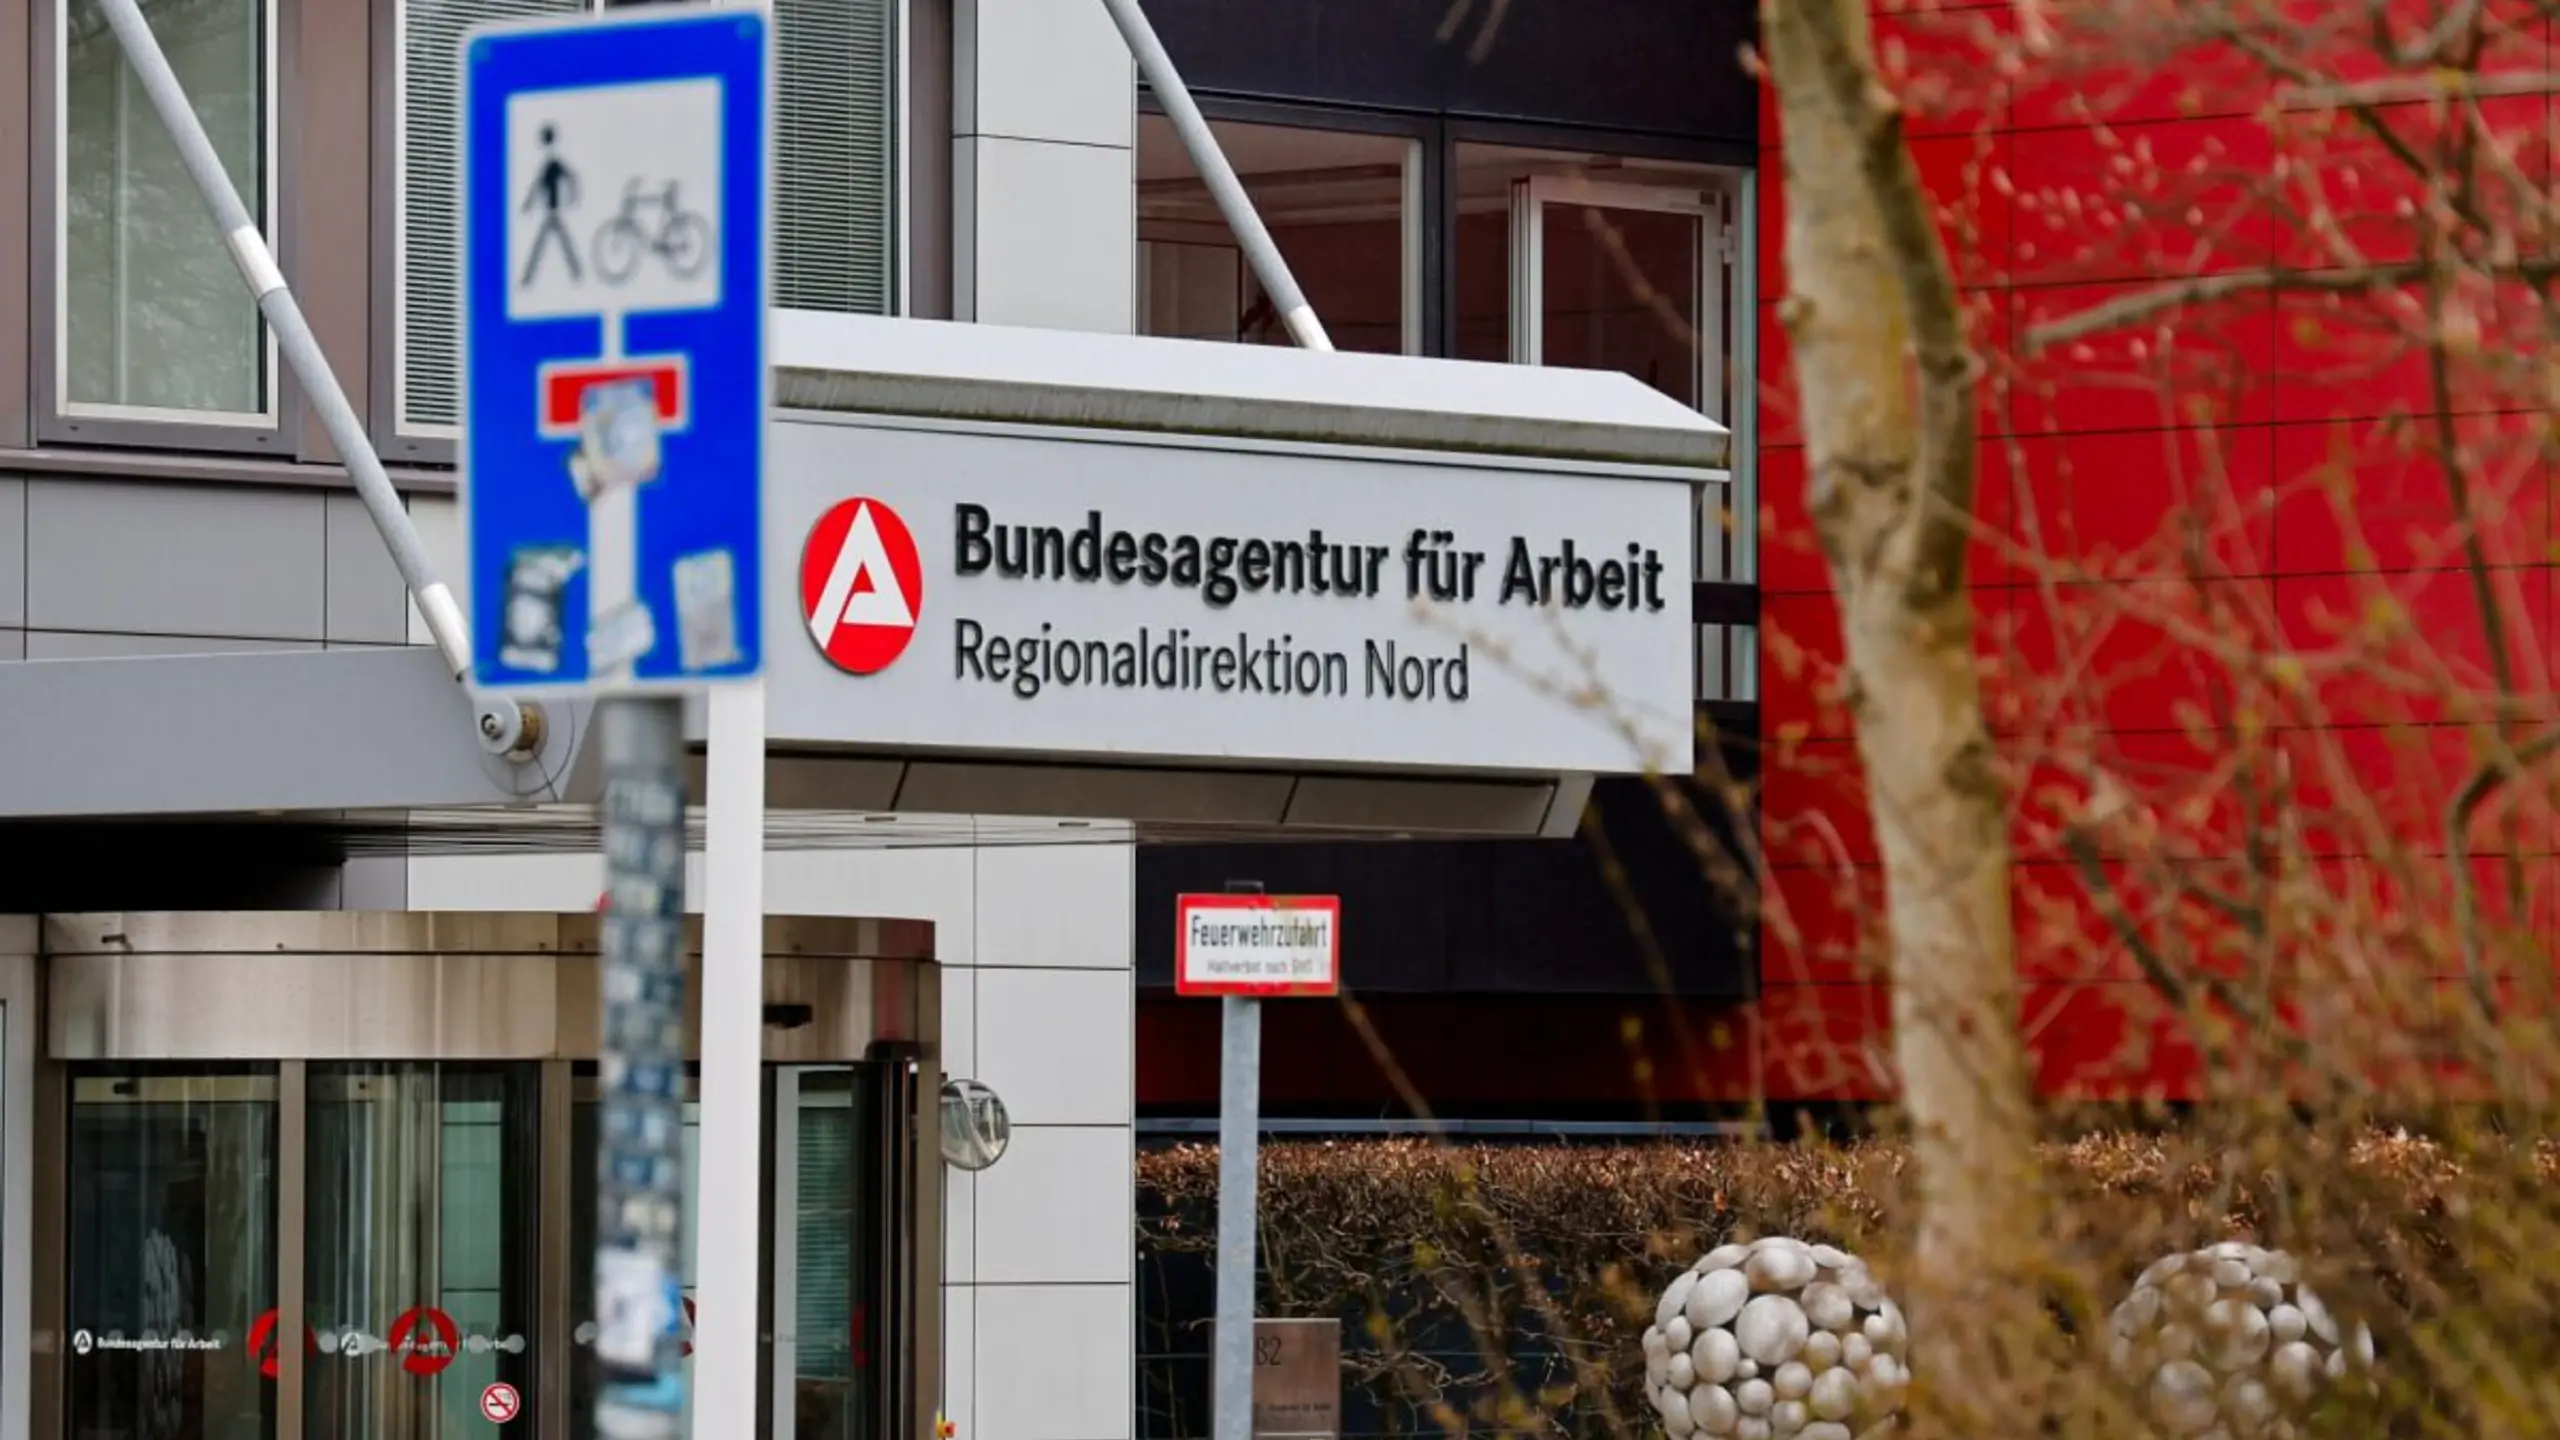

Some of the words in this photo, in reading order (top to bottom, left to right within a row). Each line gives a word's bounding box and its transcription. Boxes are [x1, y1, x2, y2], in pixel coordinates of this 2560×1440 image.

[955, 503, 1389, 605] Bundesagentur
[1402, 528, 1486, 602] für
[1499, 536, 1666, 613] Arbeit
[955, 618, 1348, 699] Regionaldirektion
[1365, 638, 1469, 702] Nord
[1191, 915, 1328, 947] Feuerwehrzufahrt
